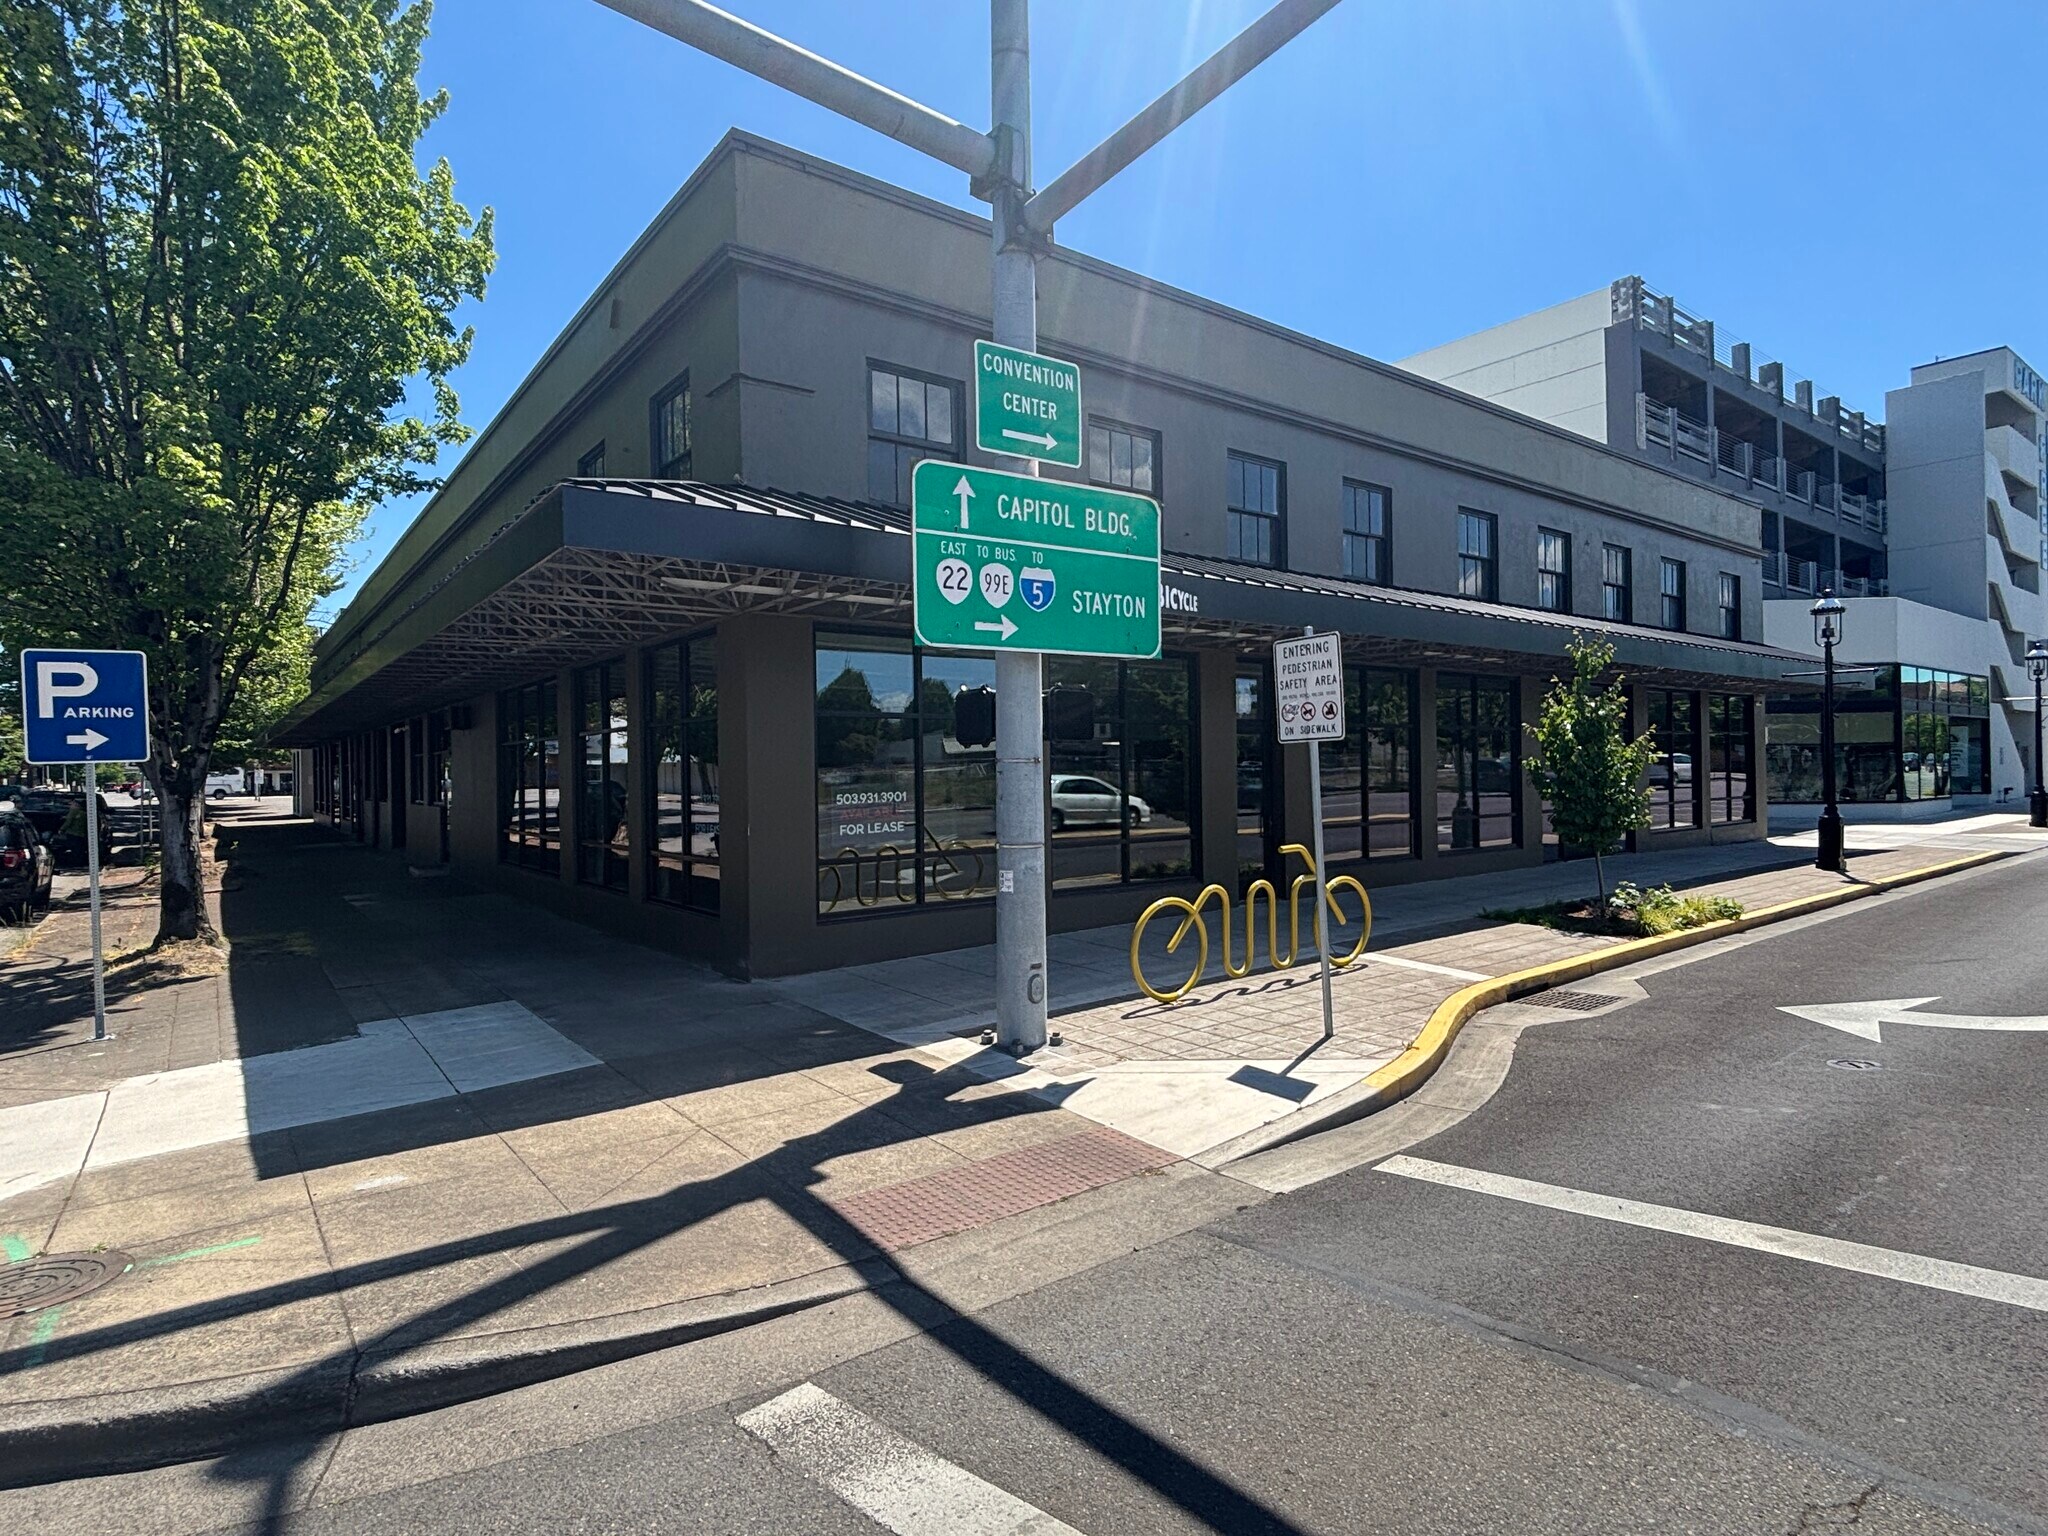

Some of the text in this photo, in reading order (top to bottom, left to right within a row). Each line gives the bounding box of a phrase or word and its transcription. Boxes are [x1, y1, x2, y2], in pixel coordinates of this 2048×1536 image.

[983, 353, 1074, 392] CONVENTION
[1003, 392, 1057, 421] CENTER
[997, 494, 1133, 537] CAPITOL BLDG.
[940, 540, 1044, 564] EAST TO BUS TO
[942, 565, 969, 591] 22
[984, 572, 1010, 595] 99E
[1032, 582, 1044, 606] 5
[1072, 589, 1146, 619] STAYTON
[1283, 641, 1330, 659] ENTERING
[1282, 659, 1333, 675] PEDESTRIAN
[1280, 674, 1338, 691] SAFETY AREA
[1284, 723, 1337, 736] ON SIDEWALK
[836, 791, 907, 806] 503.931.3901
[839, 821, 905, 836] FOR LEASE
